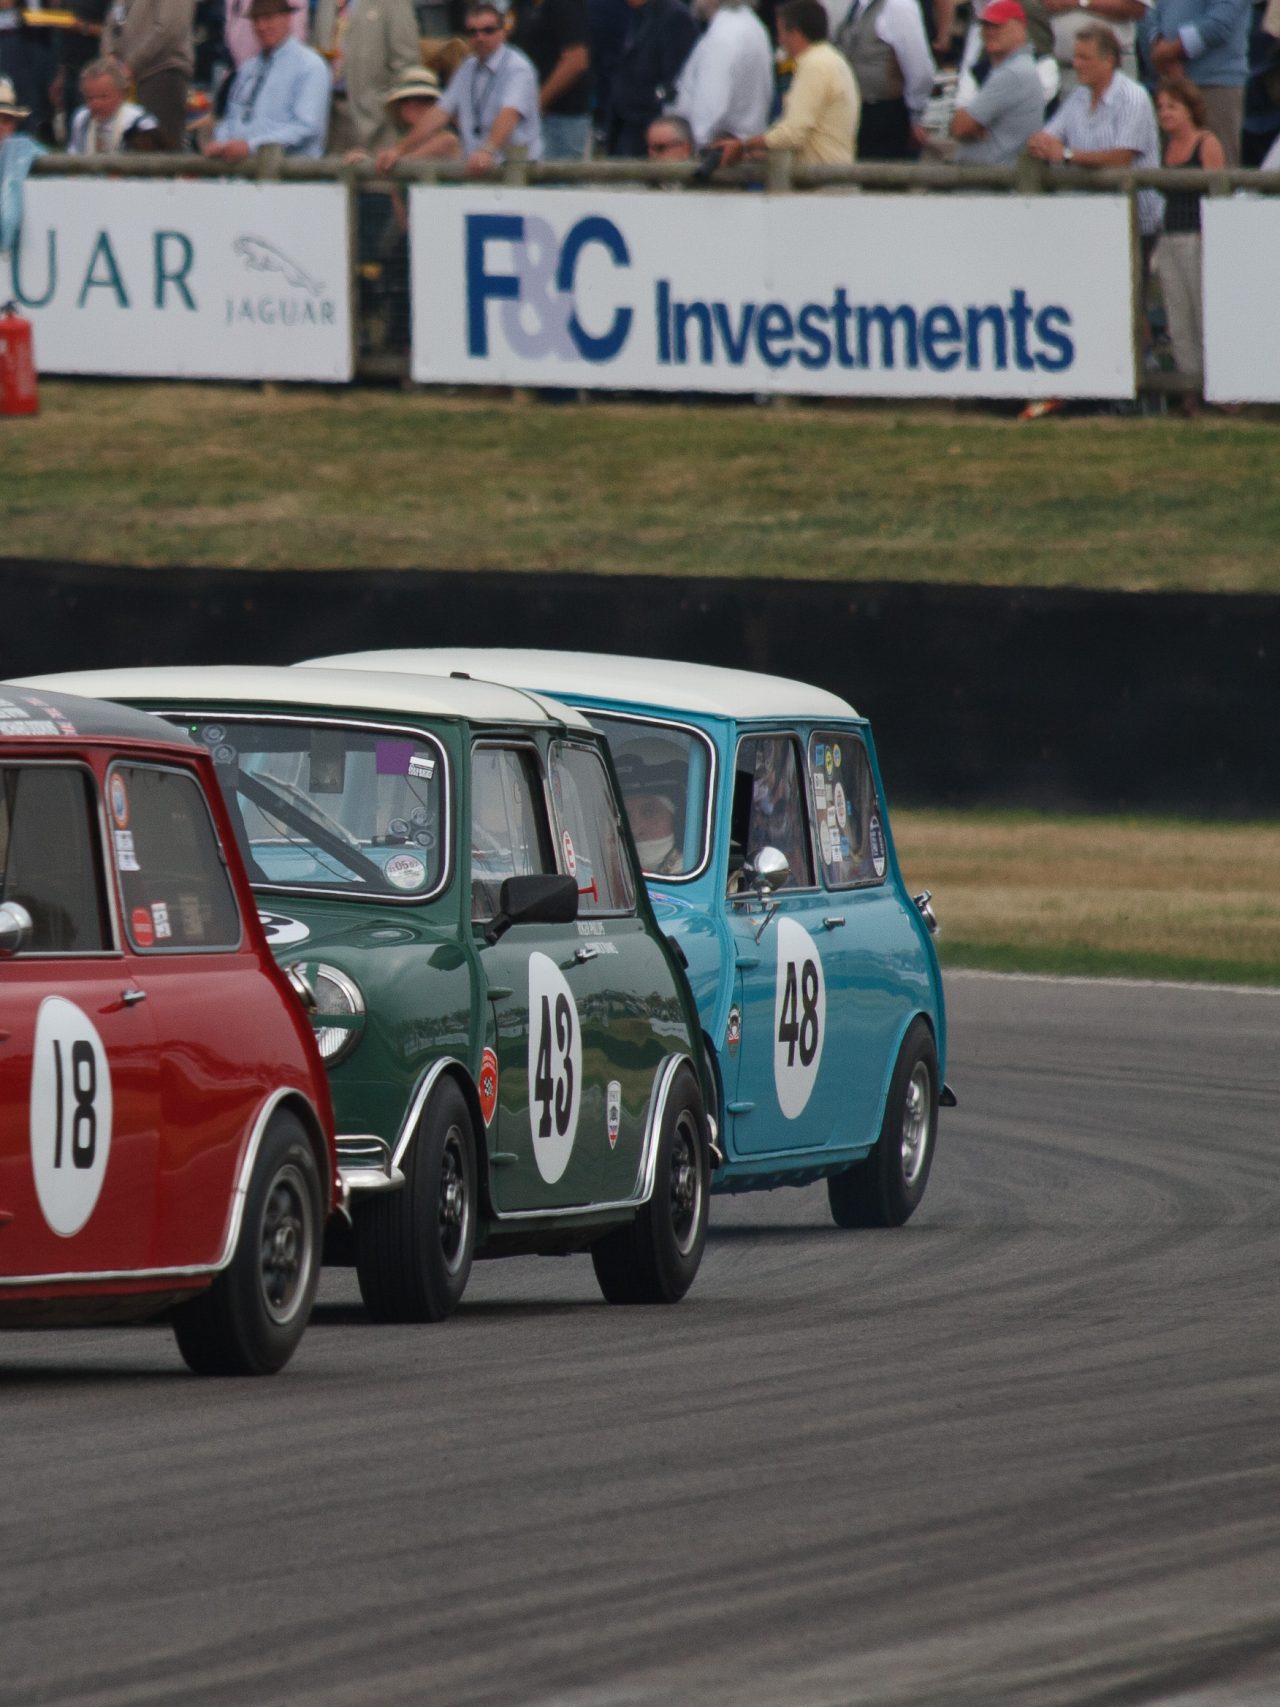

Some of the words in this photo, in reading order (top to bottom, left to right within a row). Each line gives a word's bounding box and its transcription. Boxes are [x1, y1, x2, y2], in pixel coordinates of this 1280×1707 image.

[225, 298, 335, 327] JAGUAR
[464, 214, 634, 364] F&C
[655, 279, 1075, 373] Investments
[535, 993, 574, 1138] 43
[779, 959, 819, 1067] 48
[52, 1039, 96, 1169] 18
